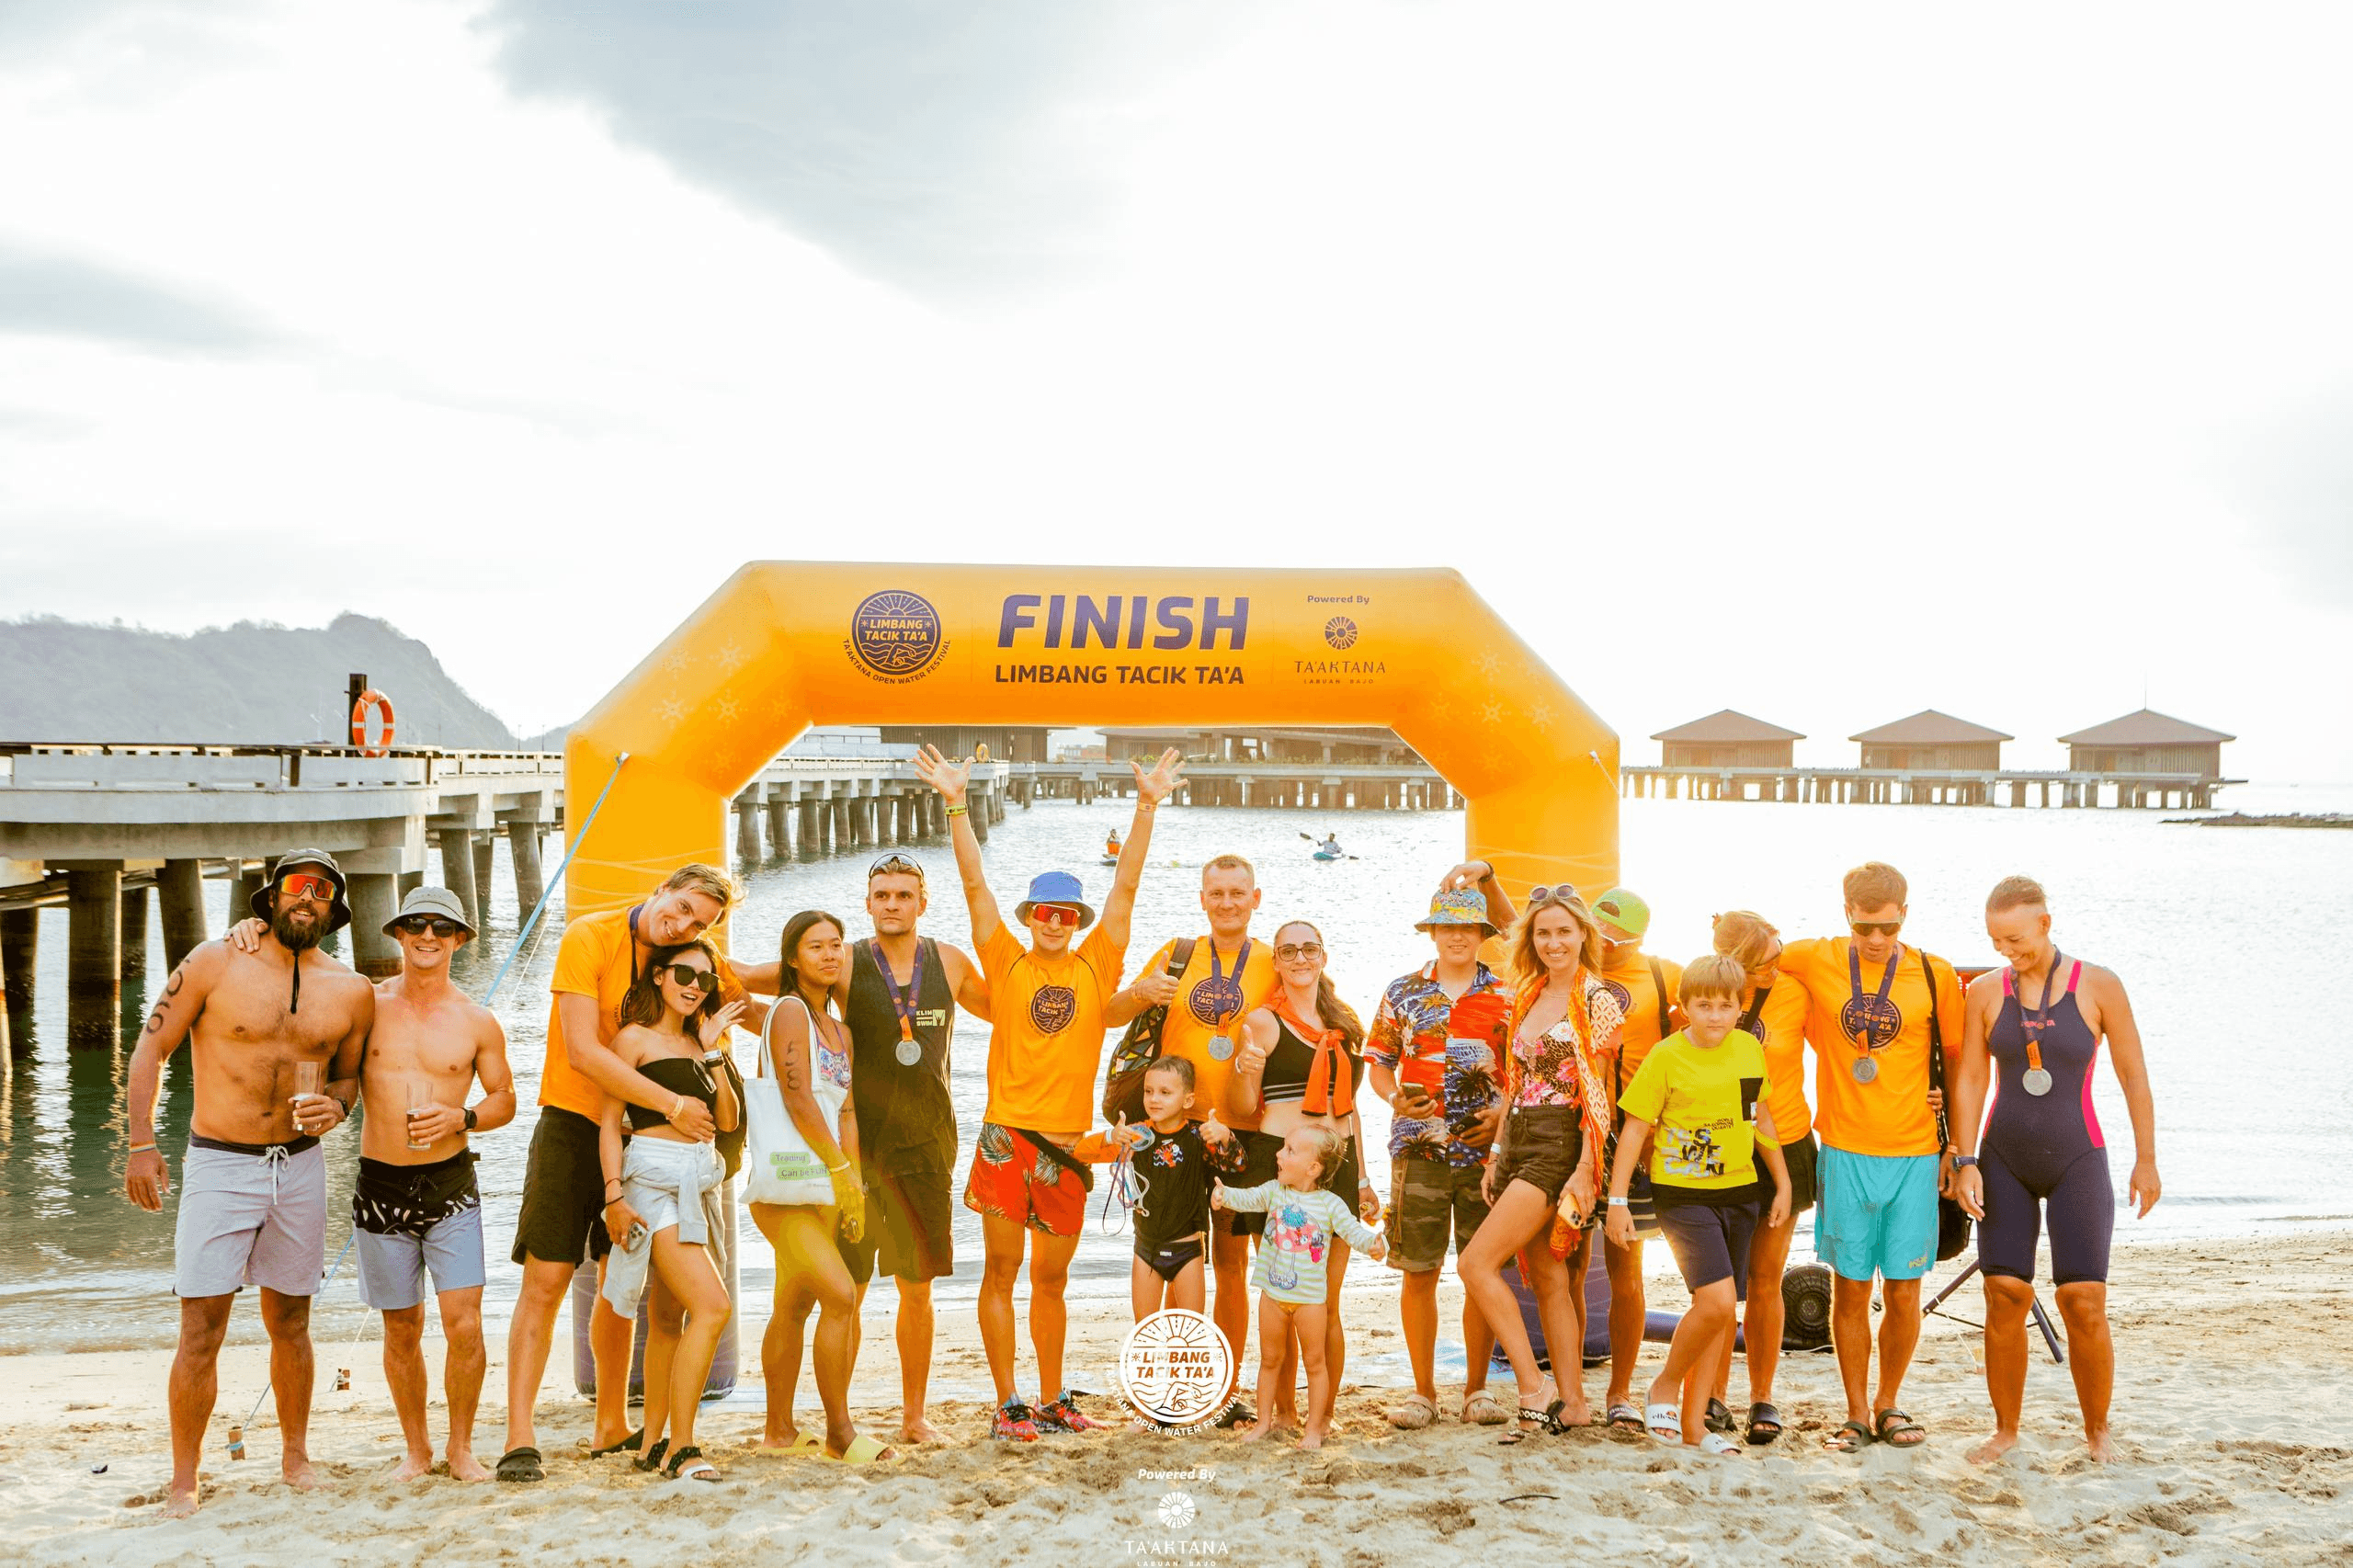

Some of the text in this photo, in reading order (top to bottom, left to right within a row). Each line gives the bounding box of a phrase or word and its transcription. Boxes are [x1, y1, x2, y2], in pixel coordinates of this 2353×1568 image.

[1307, 595, 1370, 605] Powered By
[870, 619, 923, 630] LIMBANG
[997, 594, 1250, 650] FINISH
[865, 631, 927, 641] TACIK TA'A
[872, 674, 895, 685] OPEN
[898, 672, 926, 684] WATER
[926, 640, 951, 674] FESTIVAL
[995, 665, 1245, 684] LIMBANG TACIK TA'A
